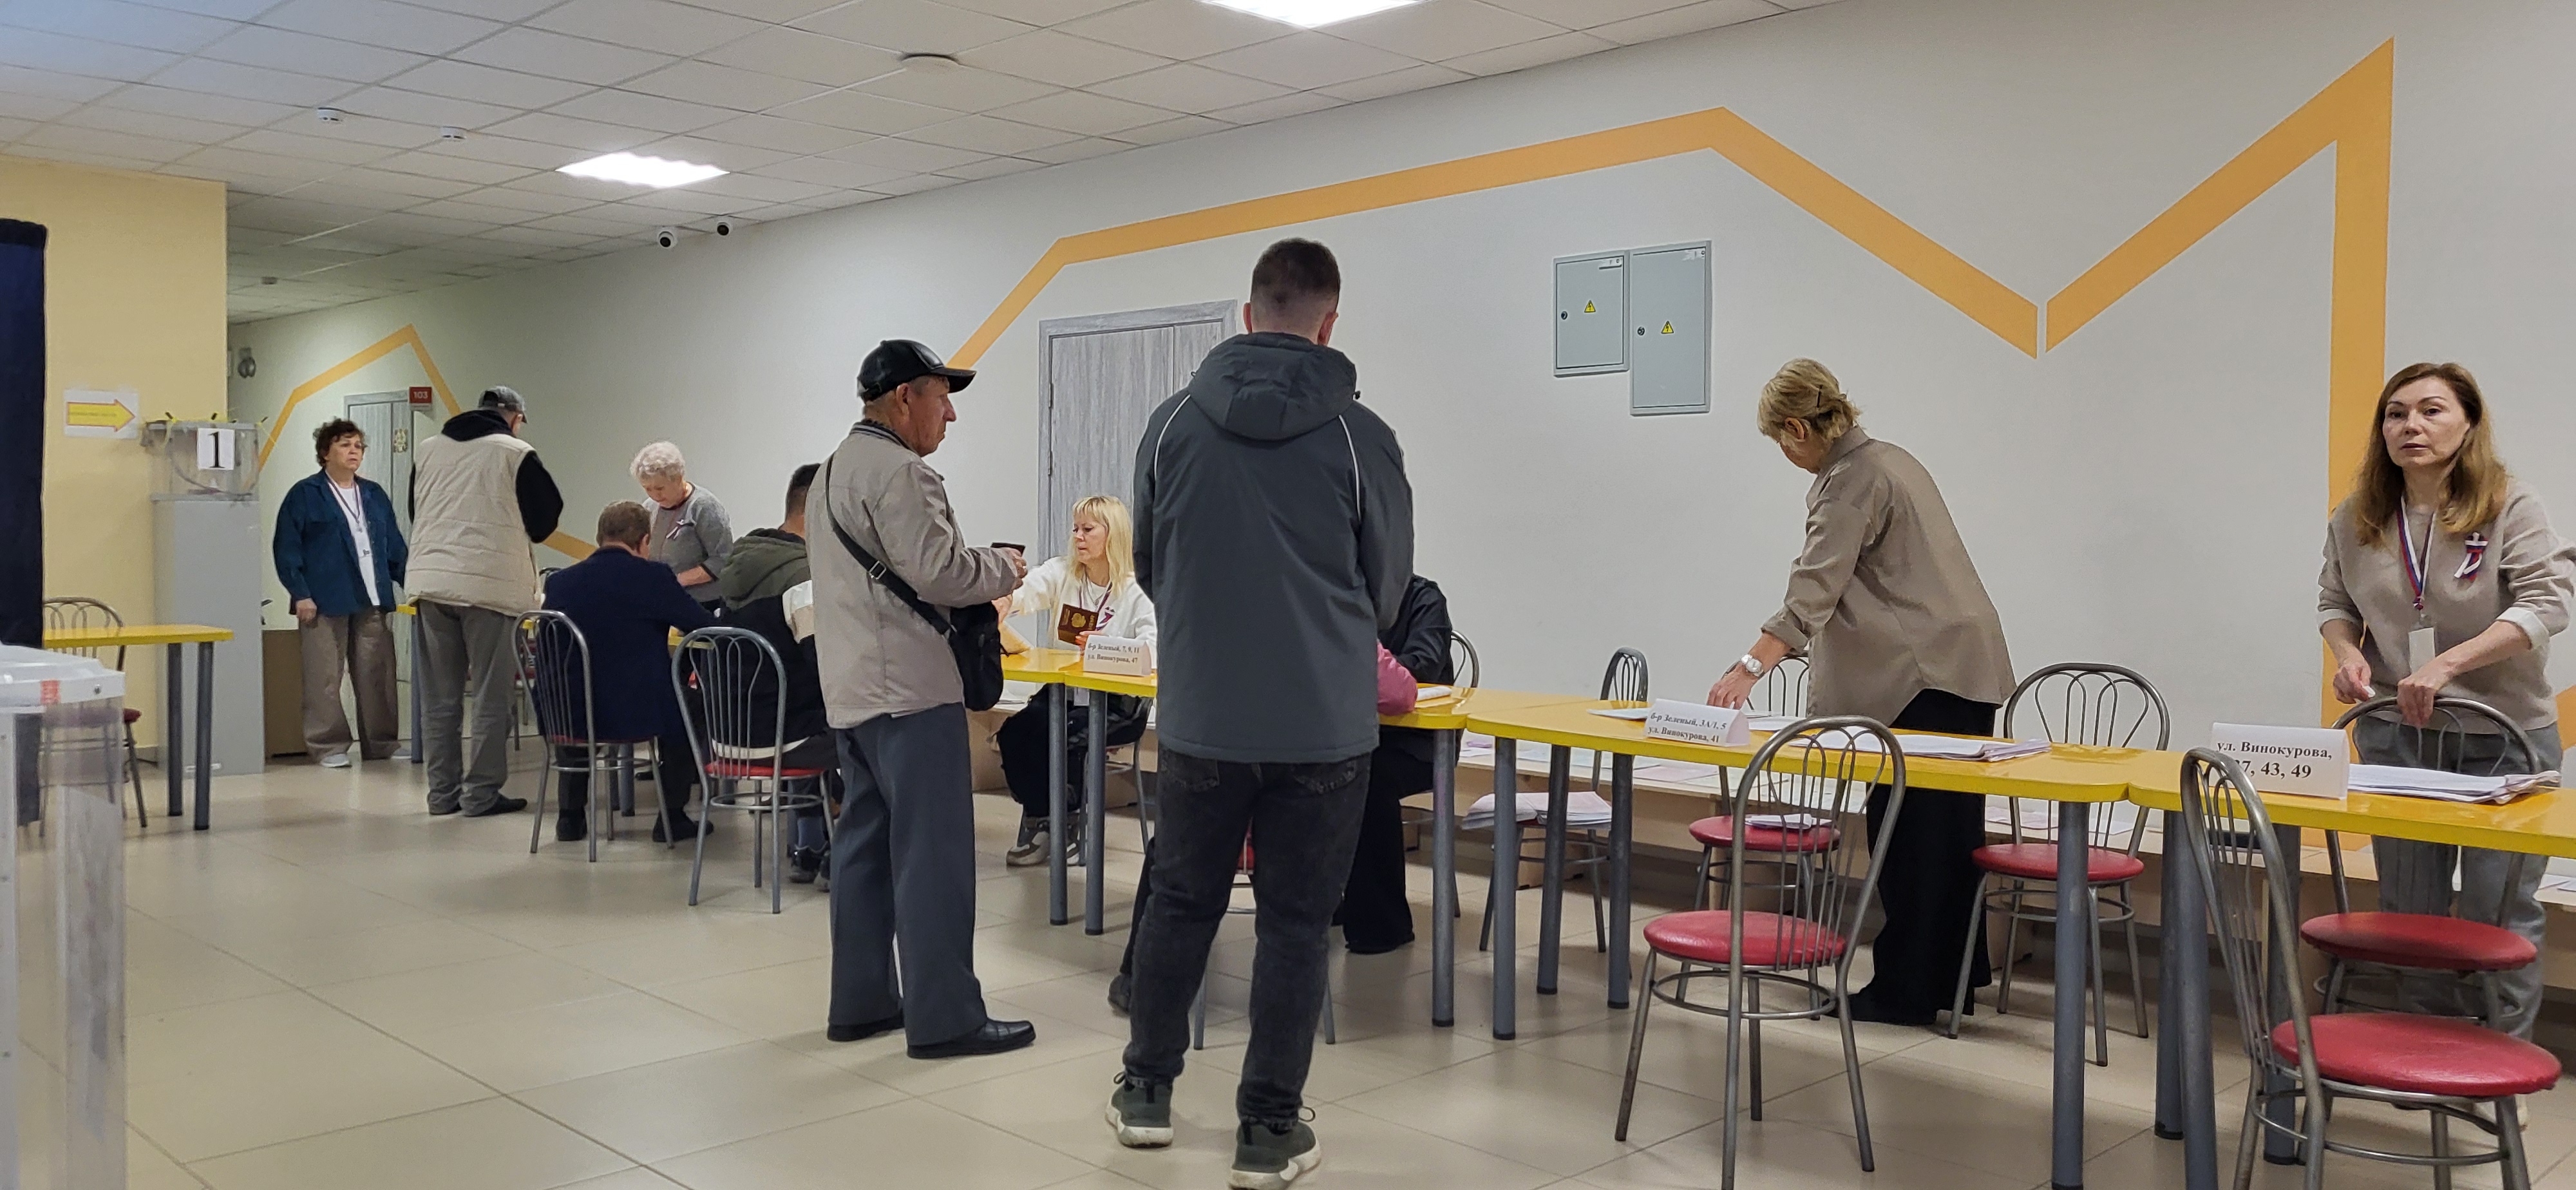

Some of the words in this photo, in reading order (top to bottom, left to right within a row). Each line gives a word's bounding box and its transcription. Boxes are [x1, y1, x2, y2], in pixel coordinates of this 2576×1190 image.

[207, 431, 225, 468] 1
[1651, 712, 1662, 722] б-р
[1664, 714, 1698, 726] Зеленый,
[1662, 727, 1709, 742] Винокурова,
[2217, 742, 2236, 751] ул.
[2240, 741, 2332, 760] Винокурова,
[2260, 762, 2285, 779] 43,
[2291, 764, 2311, 778] 49
